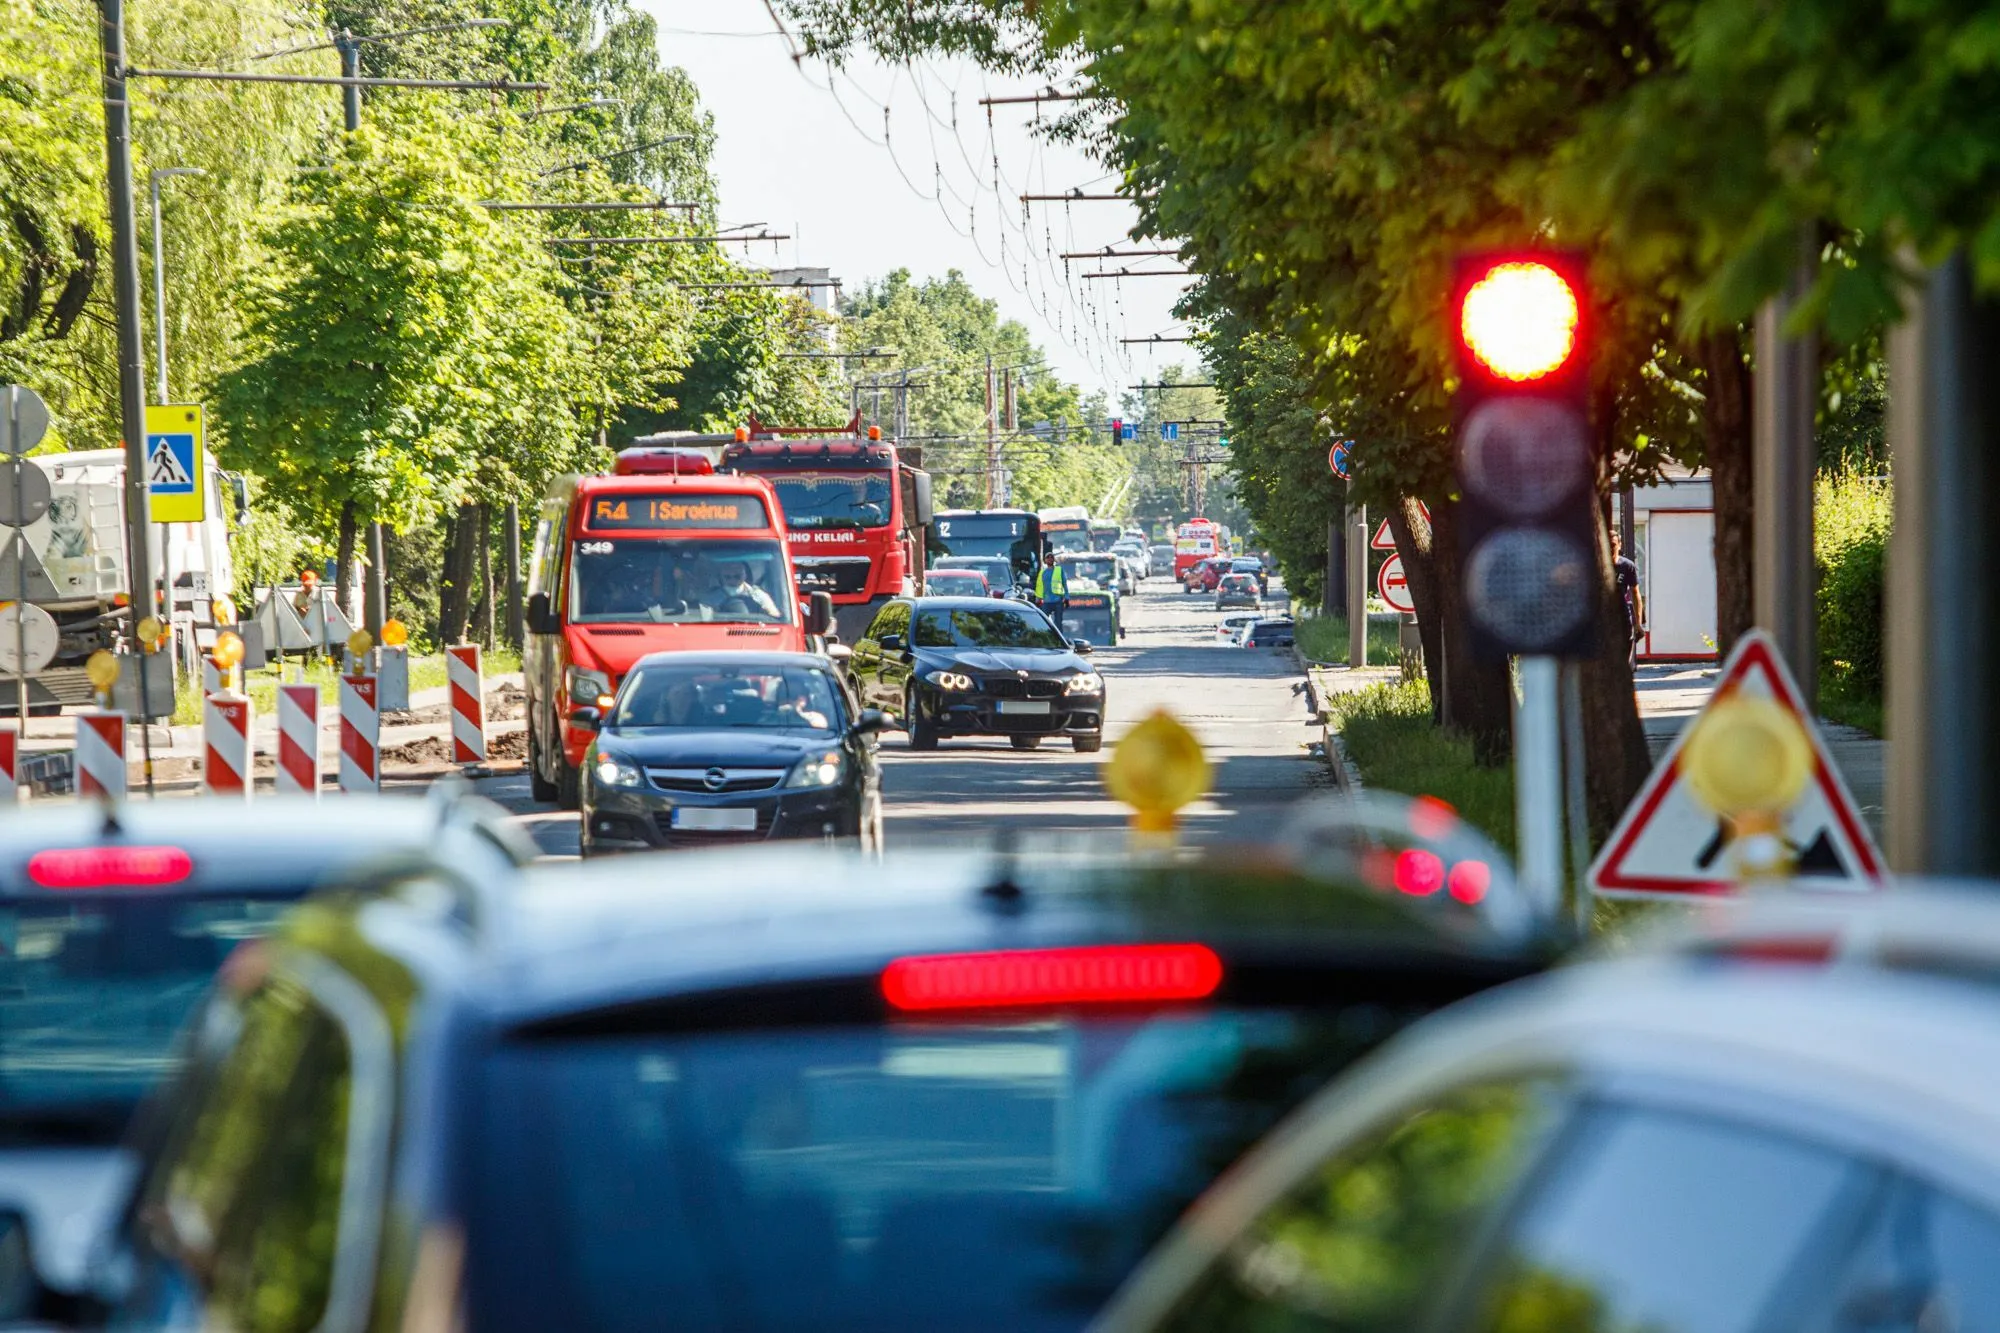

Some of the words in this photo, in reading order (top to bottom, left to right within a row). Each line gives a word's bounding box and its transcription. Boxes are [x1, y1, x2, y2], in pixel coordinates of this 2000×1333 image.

[596, 500, 629, 520] 54
[939, 521, 951, 537] 12
[814, 532, 854, 543] KELIAI
[580, 542, 614, 555] 349
